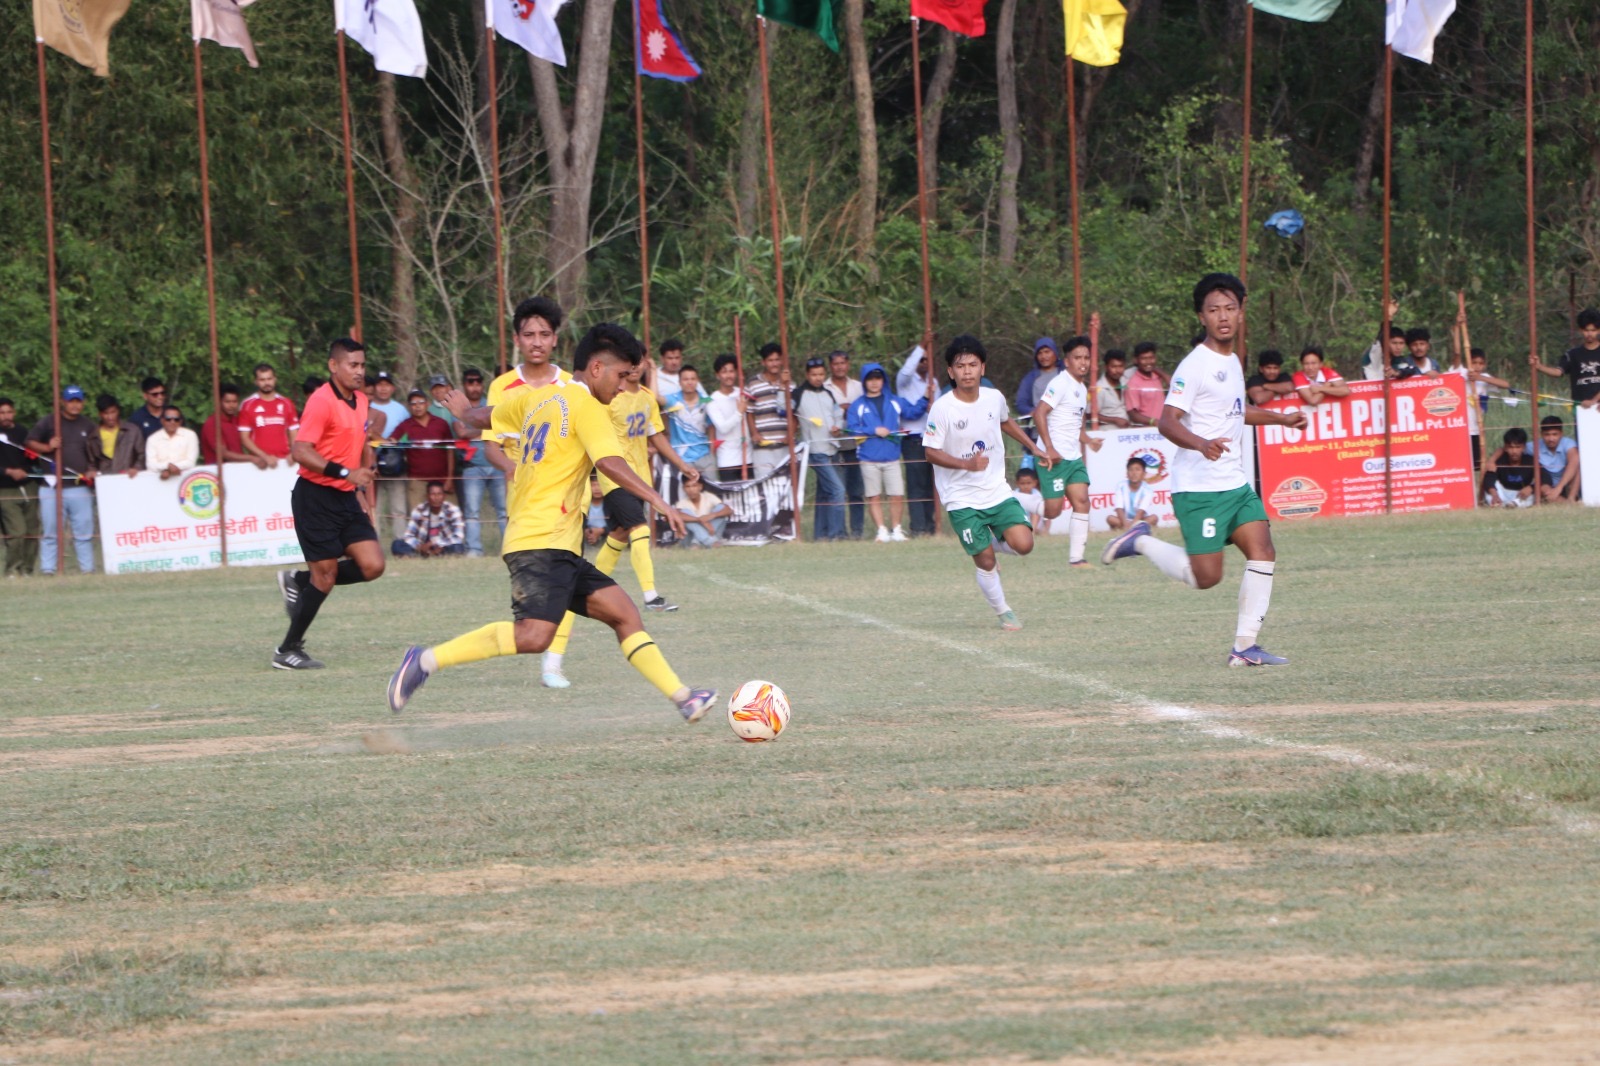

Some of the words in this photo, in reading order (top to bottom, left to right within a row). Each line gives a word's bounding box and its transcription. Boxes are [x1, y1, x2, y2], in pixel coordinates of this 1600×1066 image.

[626, 412, 646, 437] 22
[1350, 394, 1424, 438] P.B.R.
[521, 422, 551, 465] 14
[1364, 461, 1386, 471] Our
[1202, 518, 1217, 538] 6
